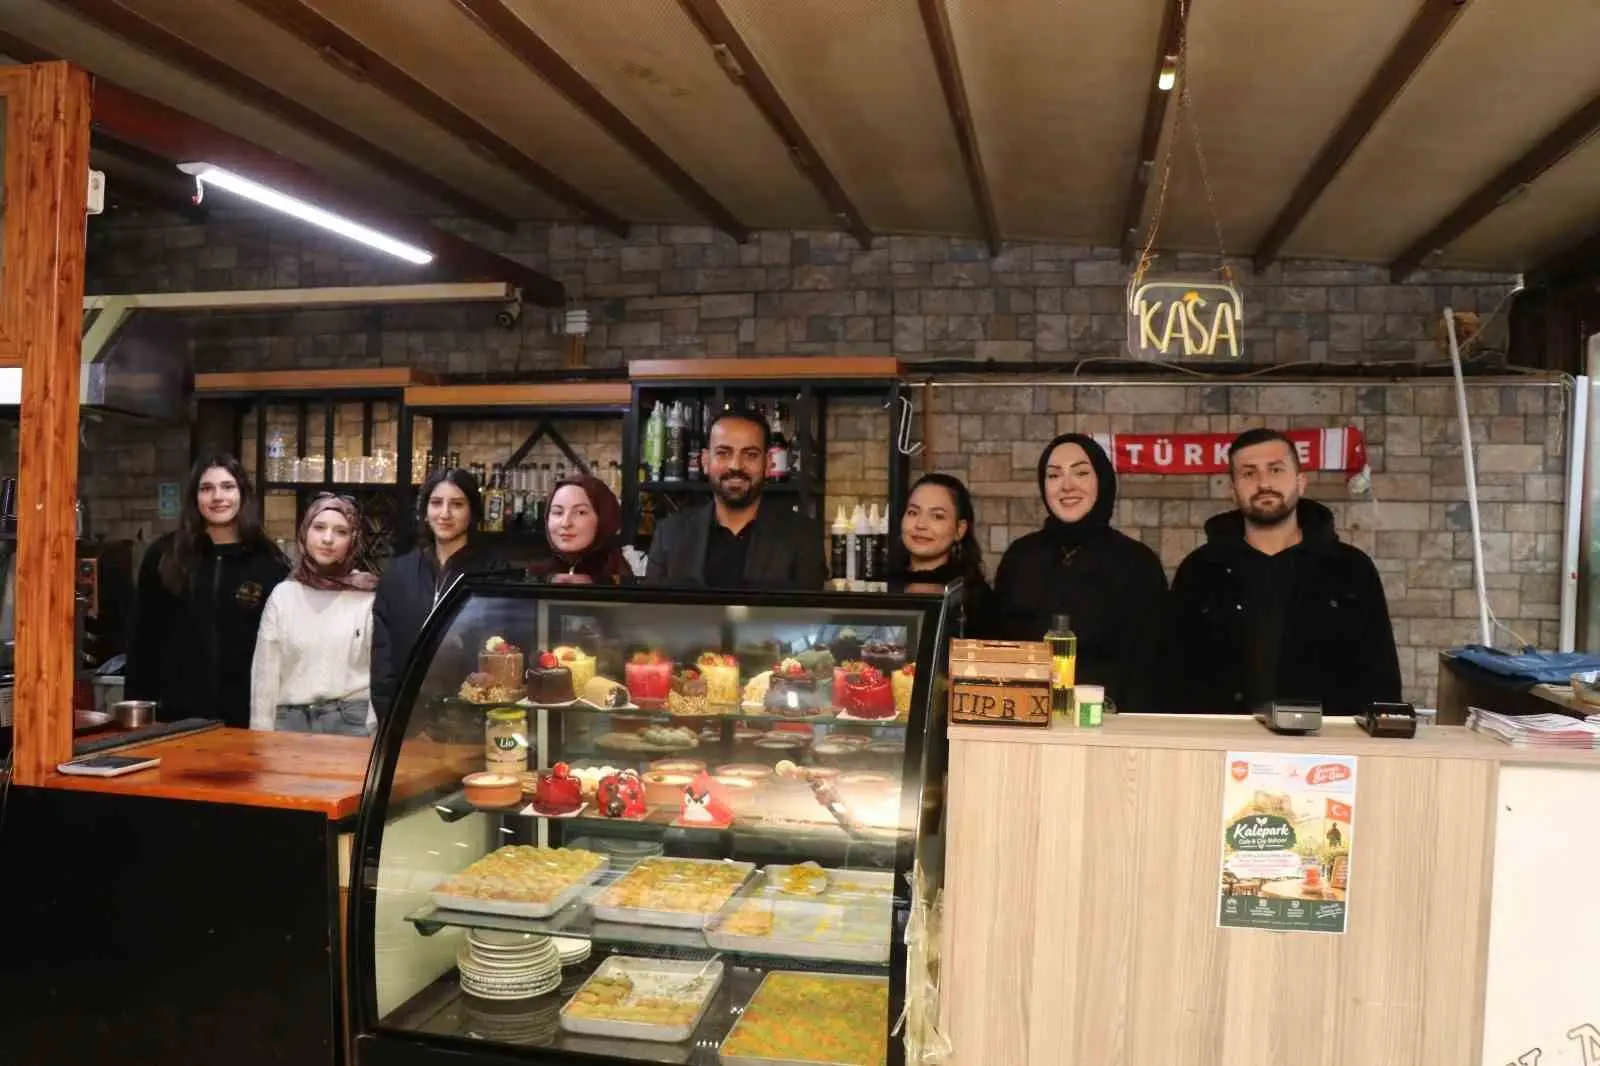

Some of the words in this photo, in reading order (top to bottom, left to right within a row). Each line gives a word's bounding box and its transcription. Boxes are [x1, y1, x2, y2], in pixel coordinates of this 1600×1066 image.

[1139, 298, 1238, 357] KASA
[1125, 437, 1311, 467] TÜRKE
[1233, 823, 1290, 839] Kalepark
